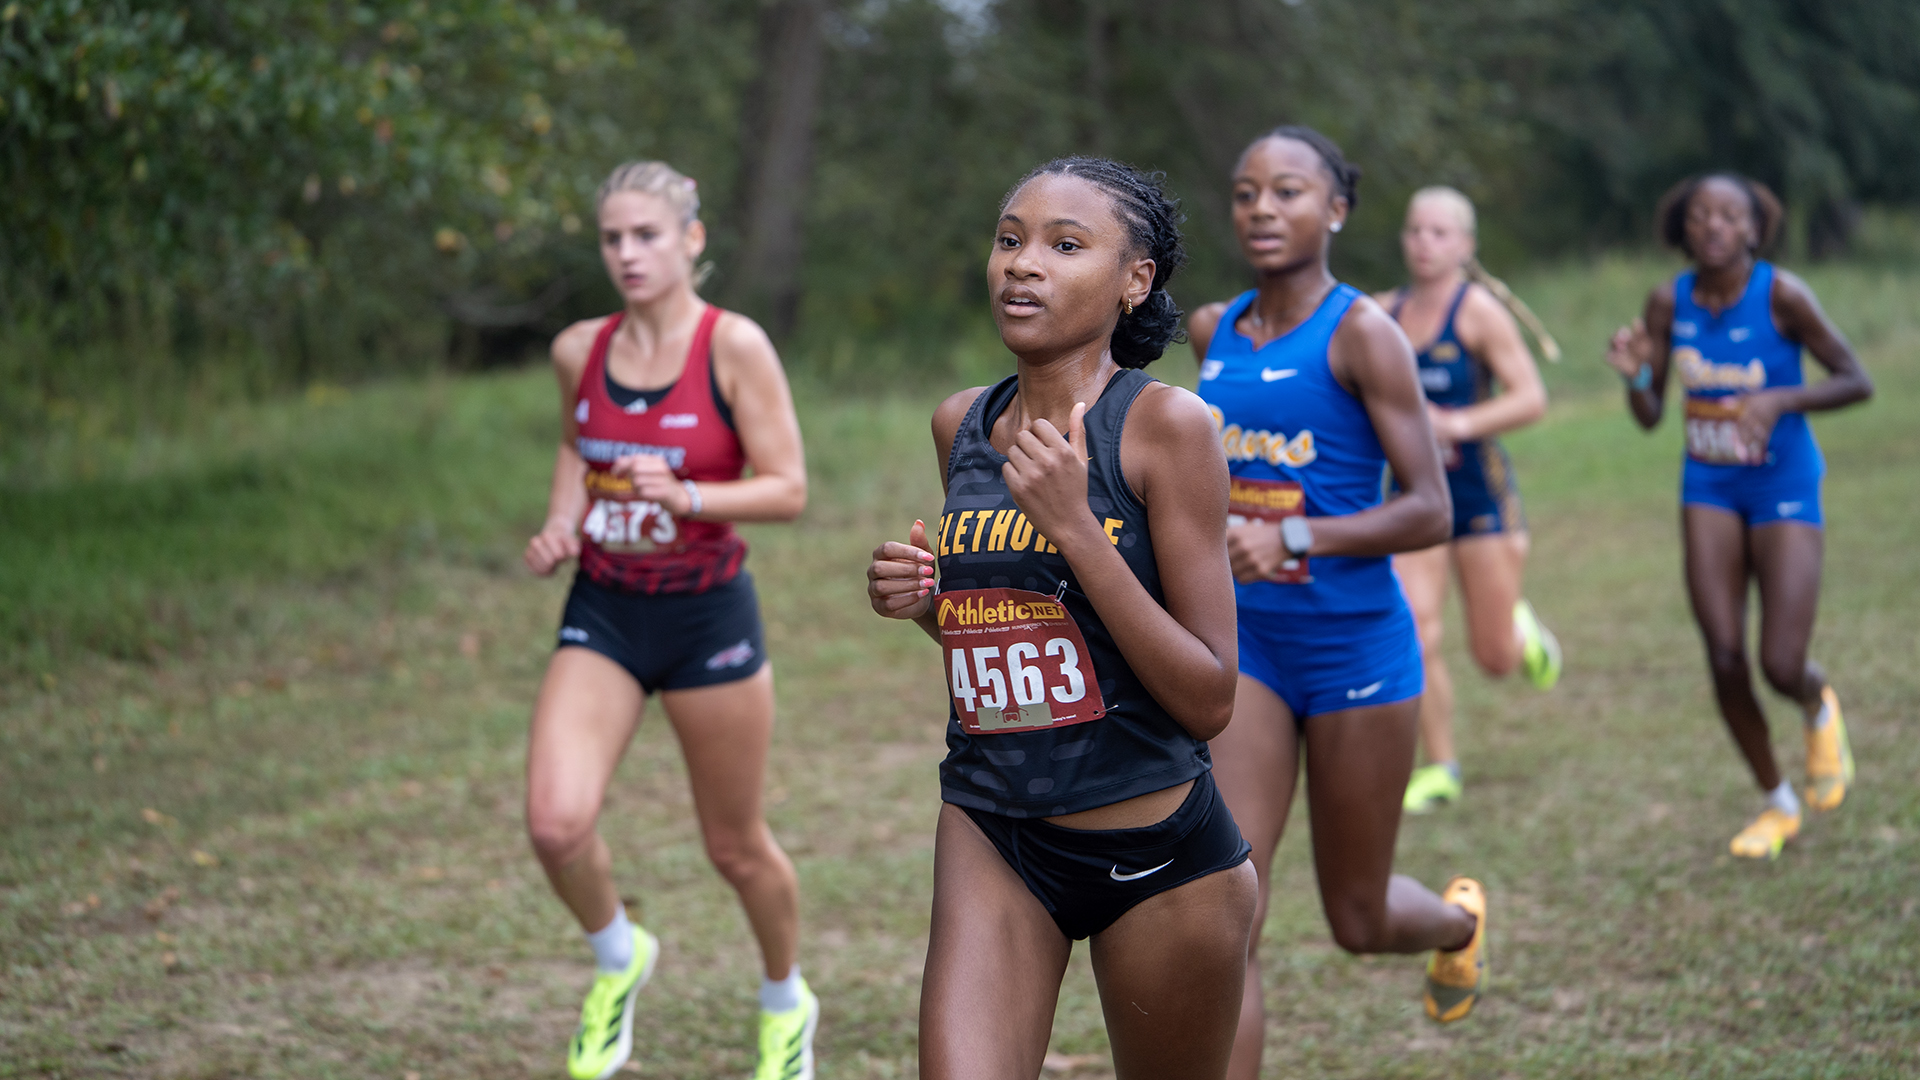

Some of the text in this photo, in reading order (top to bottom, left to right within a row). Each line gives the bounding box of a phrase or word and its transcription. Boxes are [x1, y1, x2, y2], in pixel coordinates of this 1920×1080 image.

[583, 498, 677, 543] 4573
[1035, 605, 1062, 616] NET
[951, 637, 1087, 713] 4563
